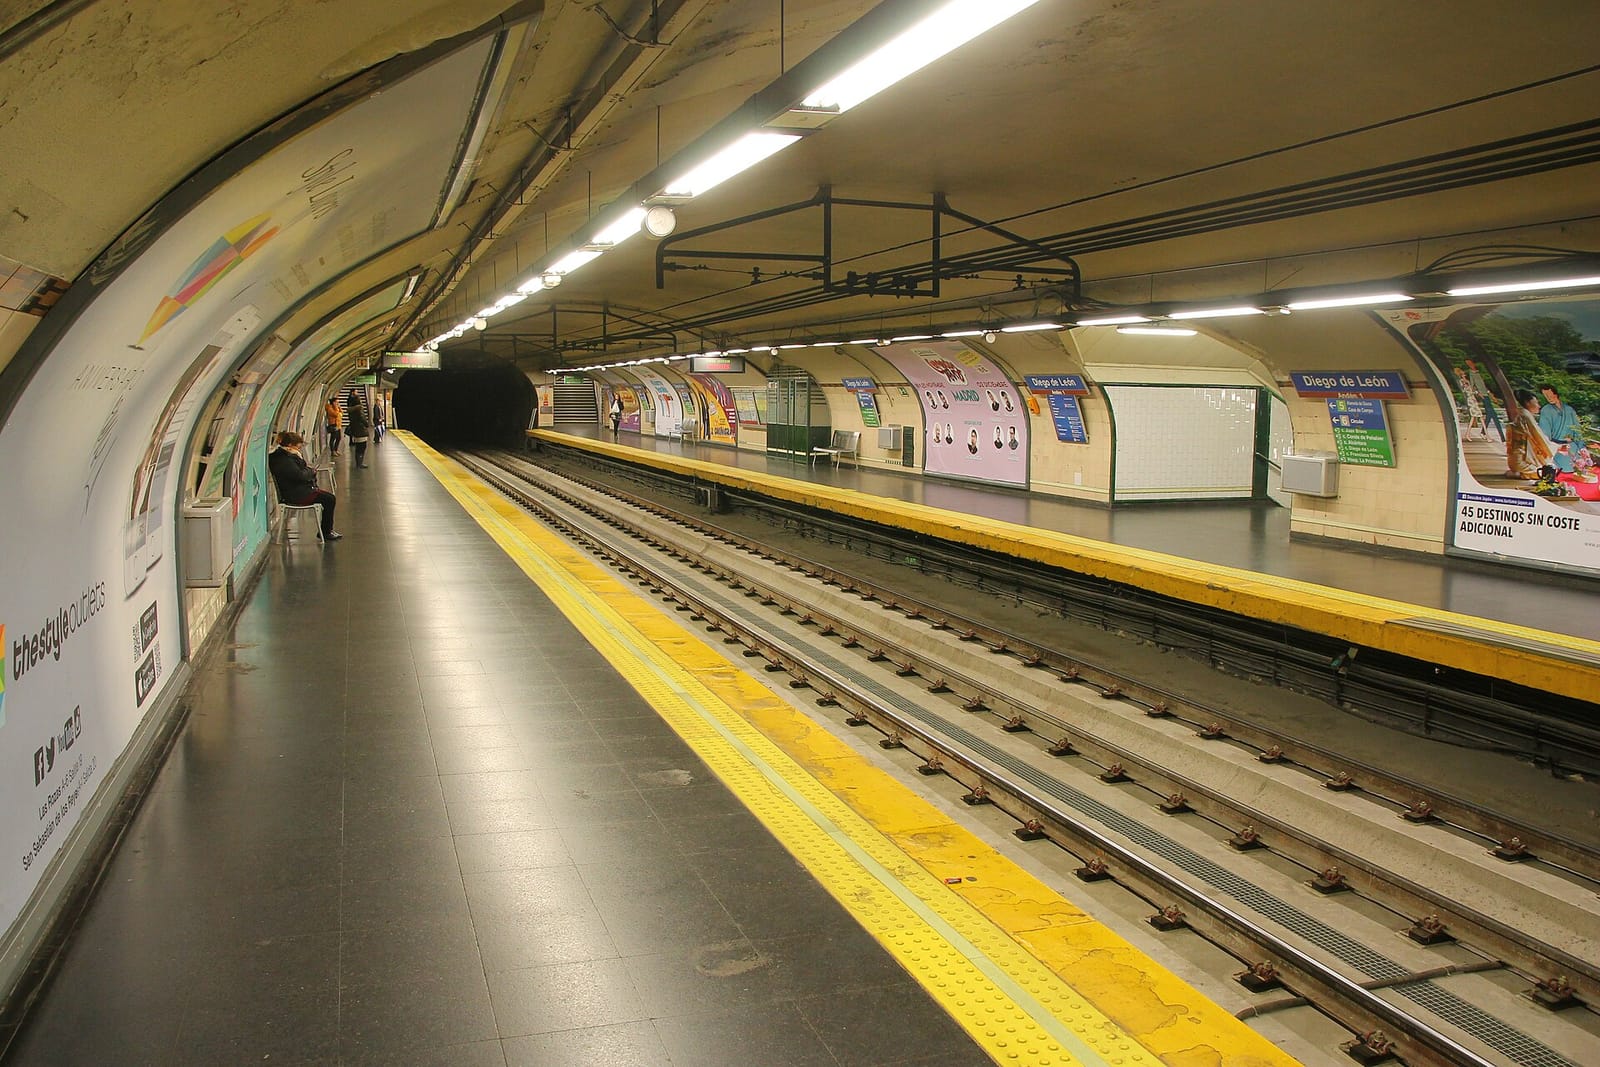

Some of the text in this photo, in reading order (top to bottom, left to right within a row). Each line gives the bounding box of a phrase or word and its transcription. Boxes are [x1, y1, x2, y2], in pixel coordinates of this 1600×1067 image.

[1031, 378, 1076, 388] Diego de León
[1303, 376, 1390, 388] Diego de León
[952, 390, 980, 402] MADRID
[1461, 506, 1580, 530] 45 DESTINOS SIN COSTE
[1460, 521, 1513, 538] ADICIONAL
[13, 581, 106, 681] thestyleoutlets
[39, 803, 48, 820] Las
[48, 786, 62, 806] Rozas
[22, 847, 34, 871] San
[32, 818, 56, 857] Sebastián
[55, 811, 61, 828] de
[60, 801, 68, 819] los
